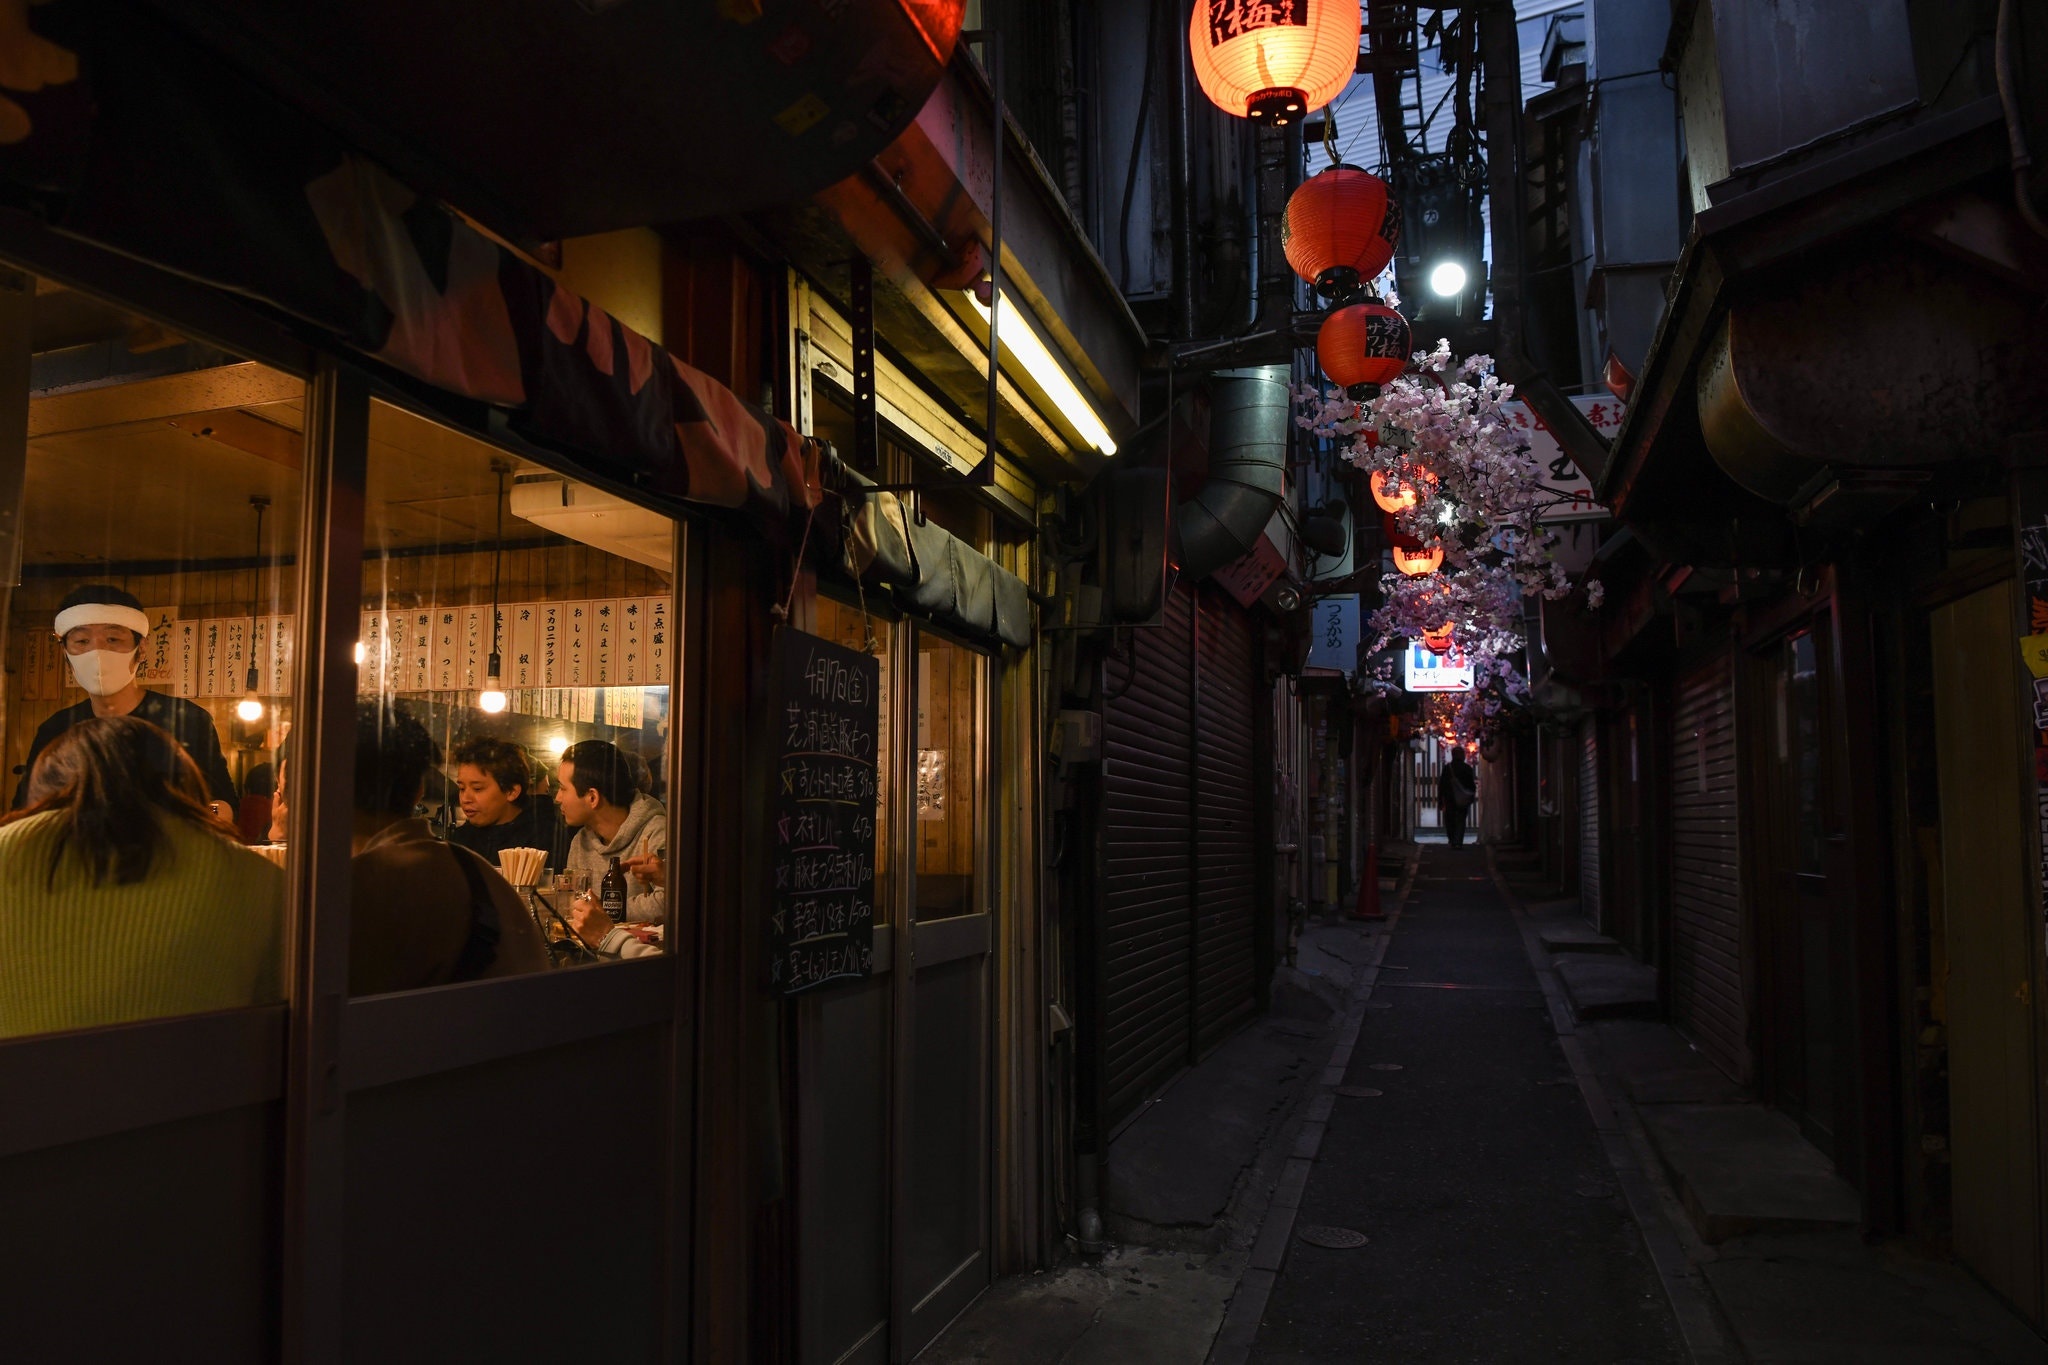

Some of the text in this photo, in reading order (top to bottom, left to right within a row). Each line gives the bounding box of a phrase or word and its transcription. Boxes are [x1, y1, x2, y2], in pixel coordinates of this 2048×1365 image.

[1366, 322, 1383, 358] サワー
[519, 609, 531, 665] 冷奴
[546, 609, 557, 666] マカロニサラダ
[573, 608, 583, 663] おしんこ
[1327, 603, 1342, 648] つるかめ
[1414, 671, 1440, 679] トイレ
